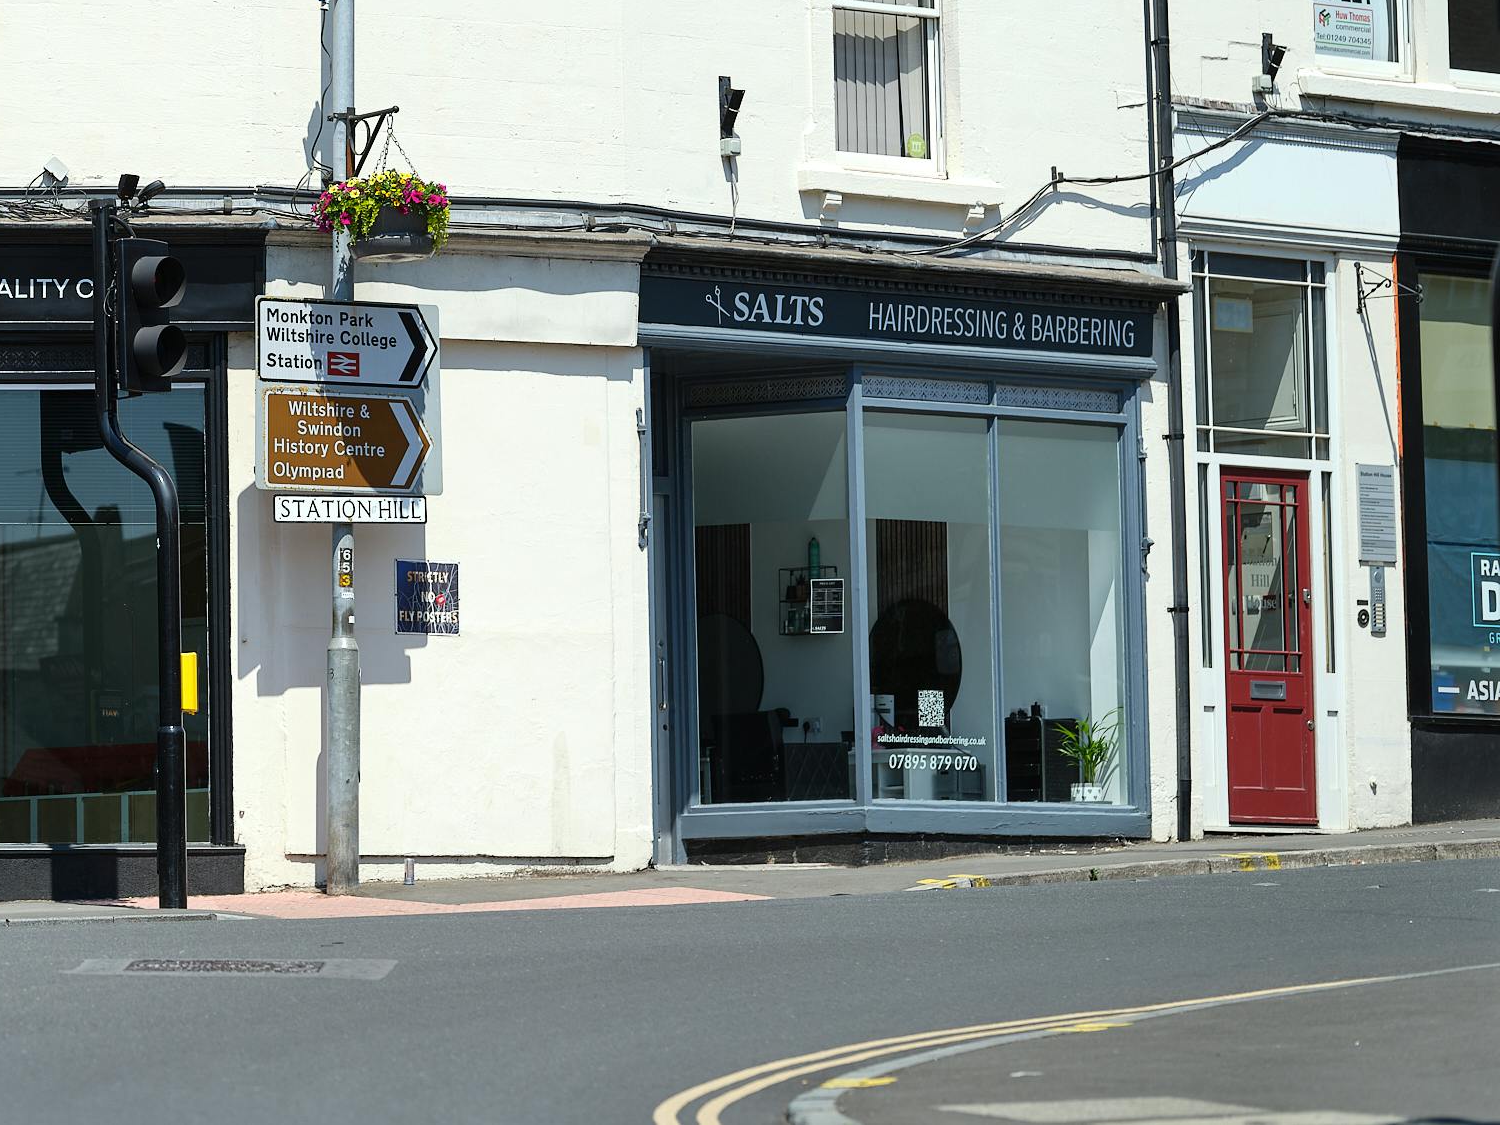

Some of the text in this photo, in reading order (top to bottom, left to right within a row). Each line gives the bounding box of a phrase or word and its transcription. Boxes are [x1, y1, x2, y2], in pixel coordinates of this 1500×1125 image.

[1349, 12, 1370, 22] Thomas
[1336, 24, 1371, 33] commercial
[267, 308, 373, 327] Monkton Park
[734, 292, 1134, 348] SALTS HAIRDRESSING & BARBERING
[266, 327, 397, 350] Wiltshire College
[266, 353, 322, 369] Station
[288, 401, 370, 418] Wiltshire &
[298, 421, 361, 437] Swindon
[274, 439, 385, 457] History Centre
[274, 461, 344, 480] Olympiad
[281, 499, 421, 519] STATION HILL
[407, 571, 449, 583] STRICTLY
[1251, 574, 1270, 587] Hill
[421, 591, 436, 603] NO
[400, 611, 458, 624] FLY POSTERS
[878, 734, 986, 746] saltshairdressingandbarbering.co.uk
[889, 754, 977, 770] 07895 879 070
